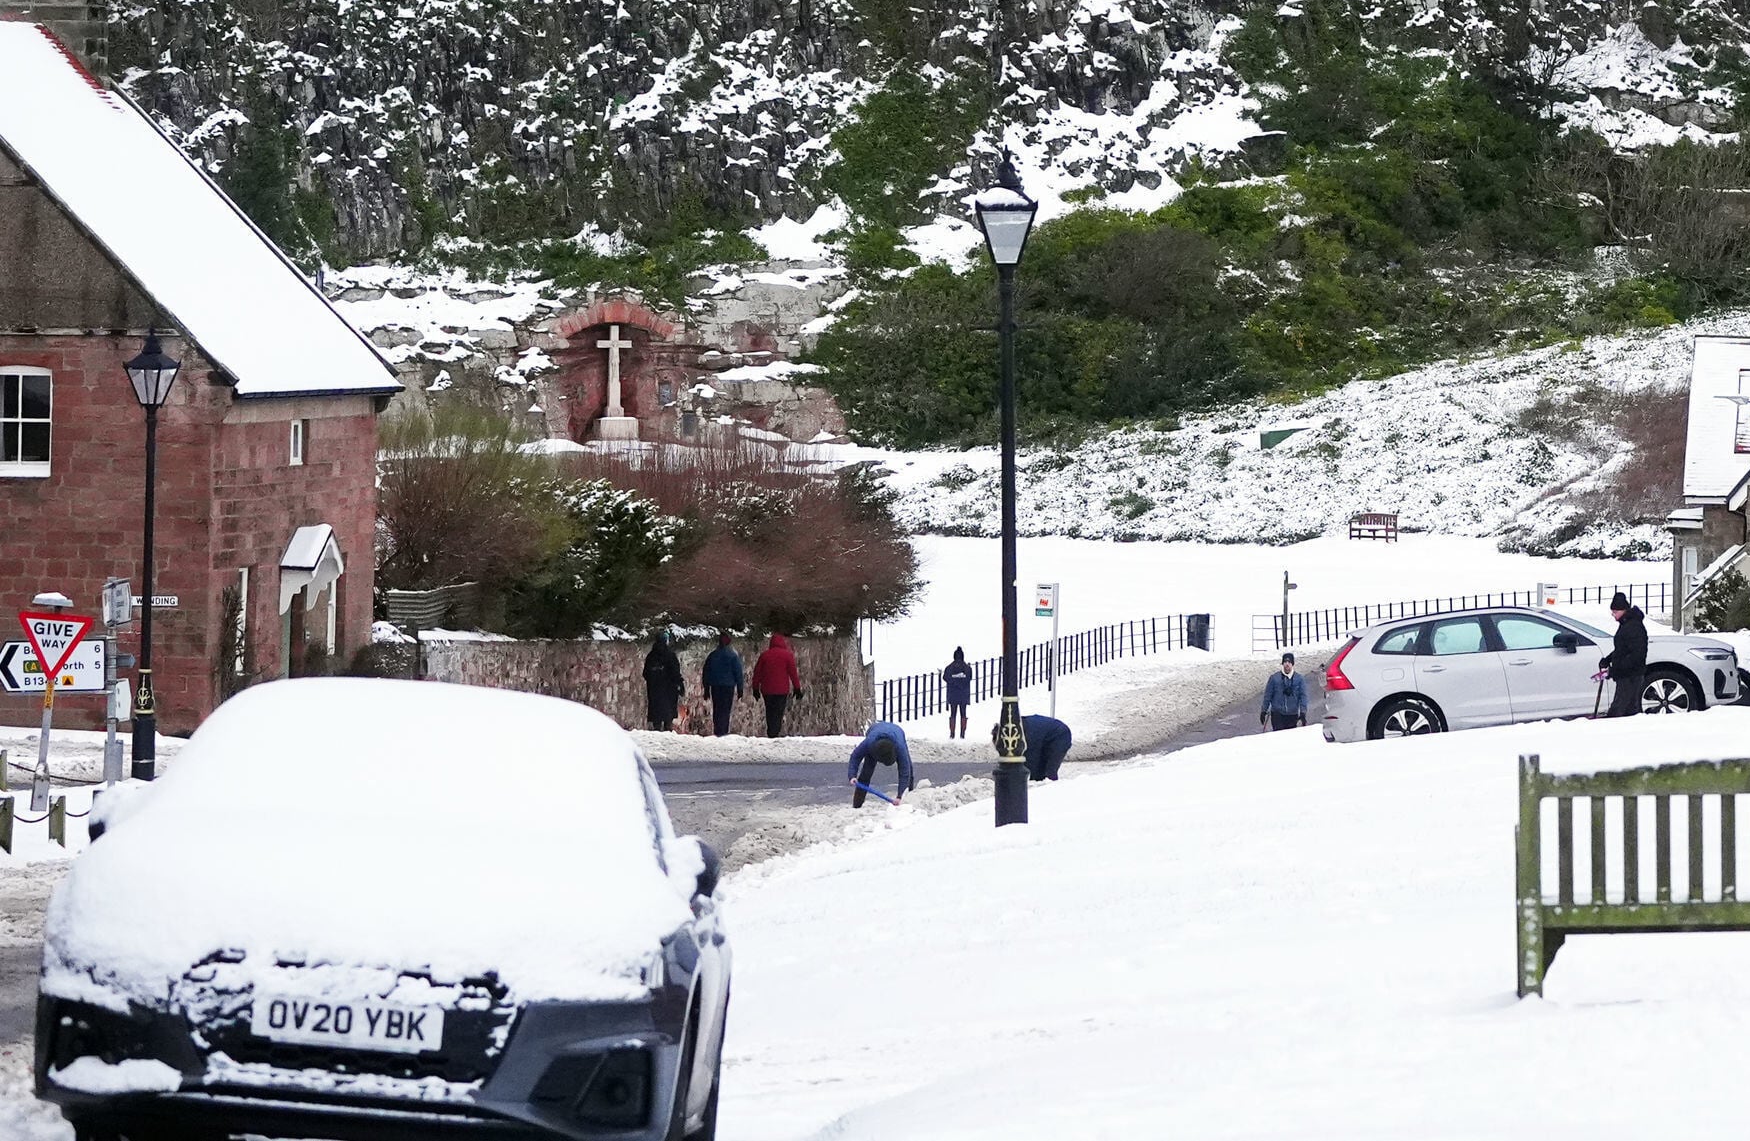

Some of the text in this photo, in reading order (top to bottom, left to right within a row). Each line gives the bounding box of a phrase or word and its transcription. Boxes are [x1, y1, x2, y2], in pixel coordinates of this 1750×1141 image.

[136, 597, 176, 605] WNDING
[34, 622, 74, 637] GIVE
[42, 639, 66, 649] WAY
[94, 644, 101, 653] 6
[62, 661, 84, 670] orth
[94, 661, 101, 670] 5
[269, 1000, 426, 1041] OV20 YBK
